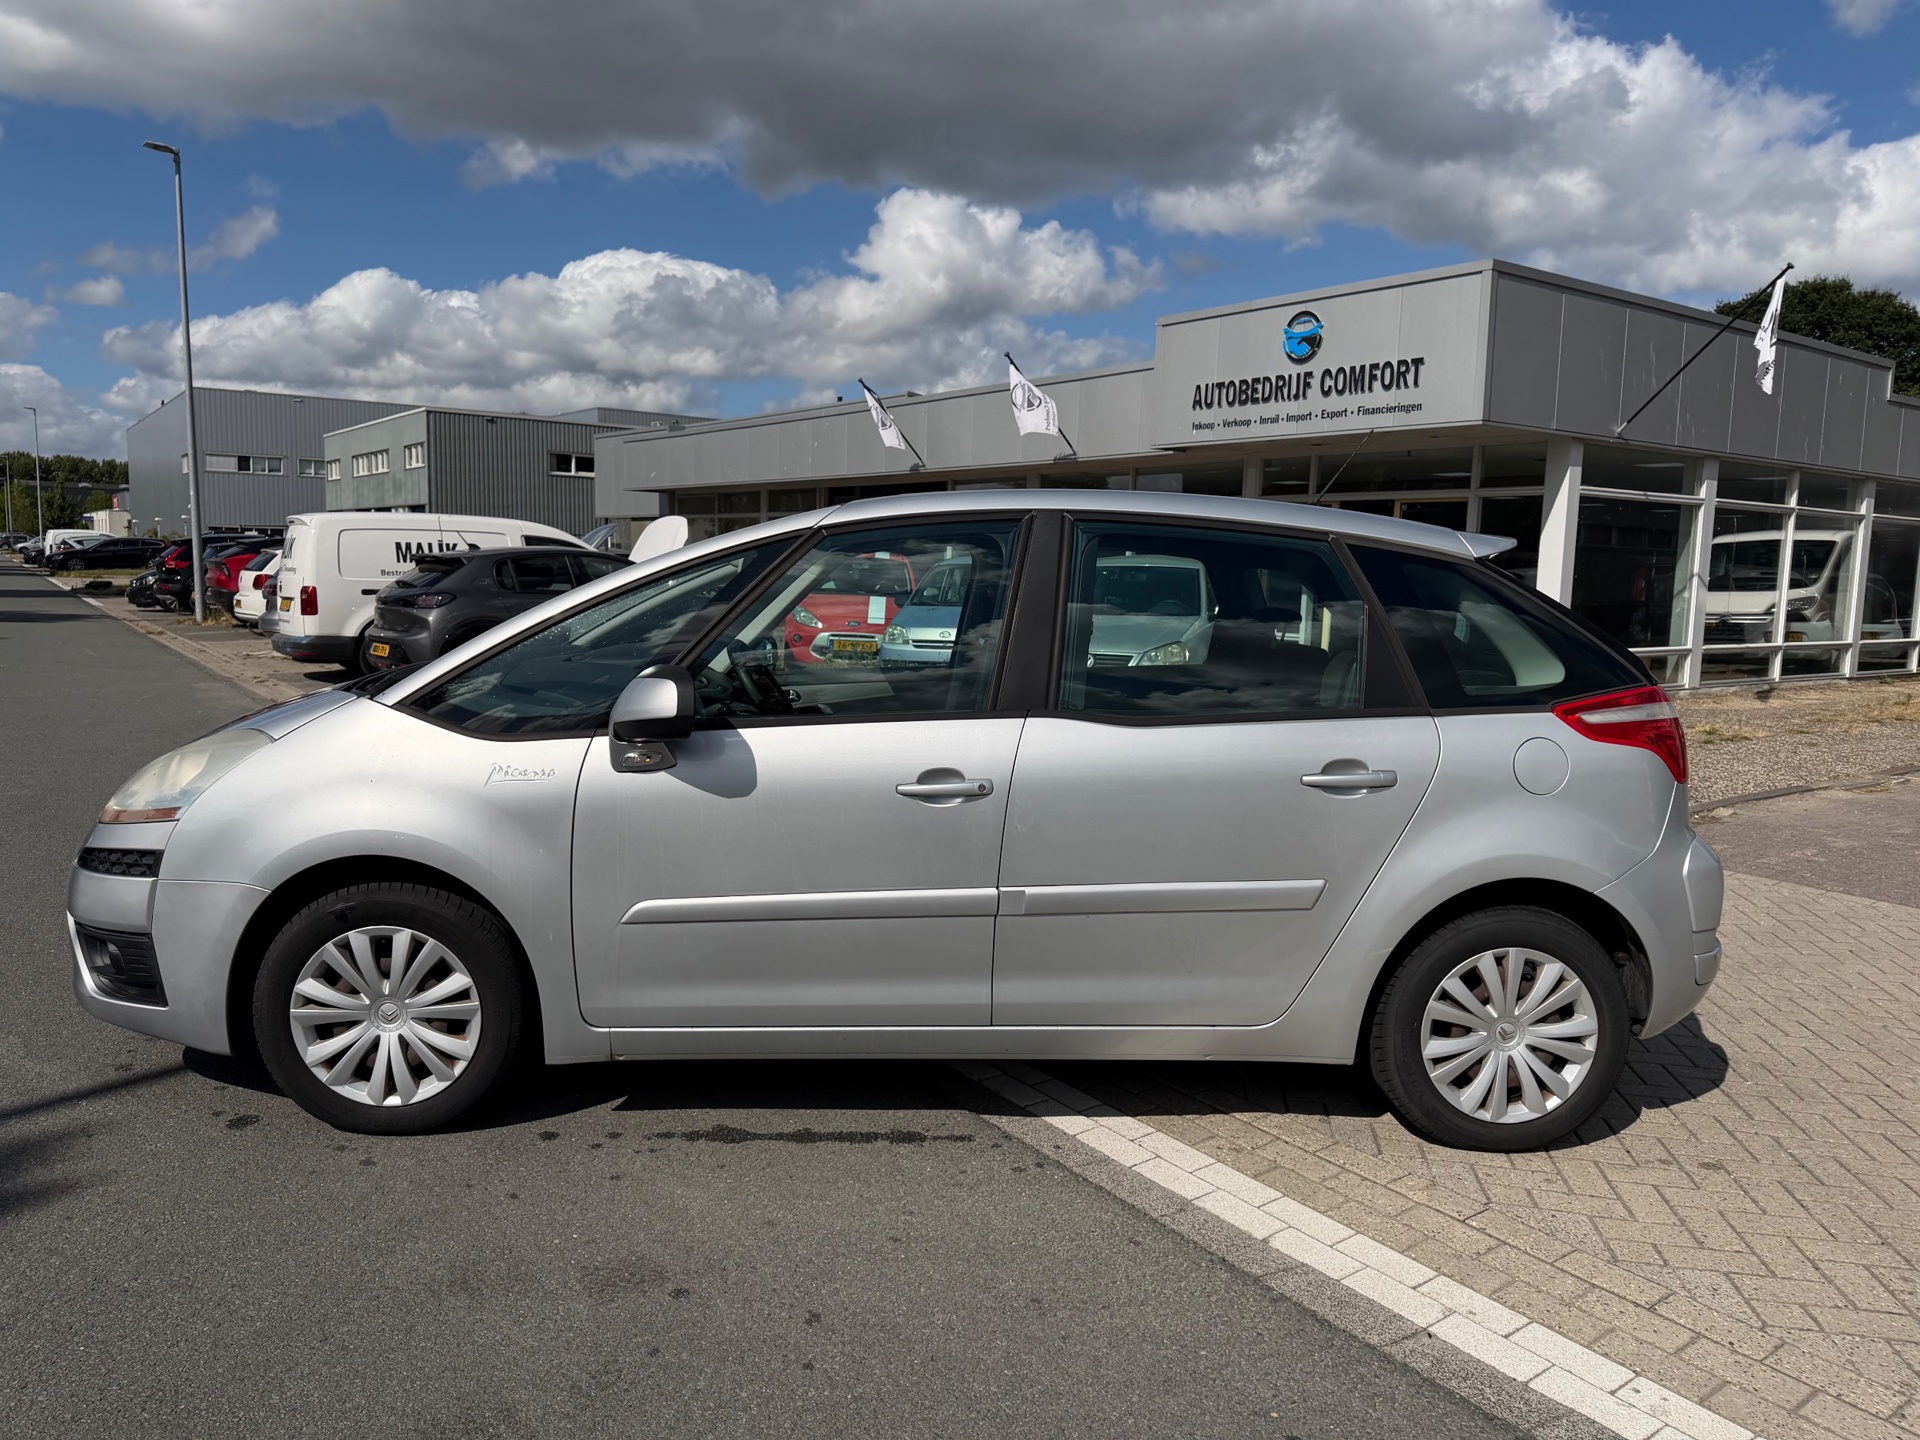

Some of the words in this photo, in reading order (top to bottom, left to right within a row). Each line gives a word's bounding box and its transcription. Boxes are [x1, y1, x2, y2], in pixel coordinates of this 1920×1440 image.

[1192, 371, 1314, 411] AUTOBEDRIJF
[1320, 357, 1425, 398] COMFORT
[1192, 421, 1215, 431] Inkoop
[1222, 418, 1251, 428] Verkoop
[1259, 414, 1279, 425] Inruil
[1286, 411, 1312, 423] Import
[1321, 407, 1348, 420] Export
[1357, 402, 1422, 416] Financieringen
